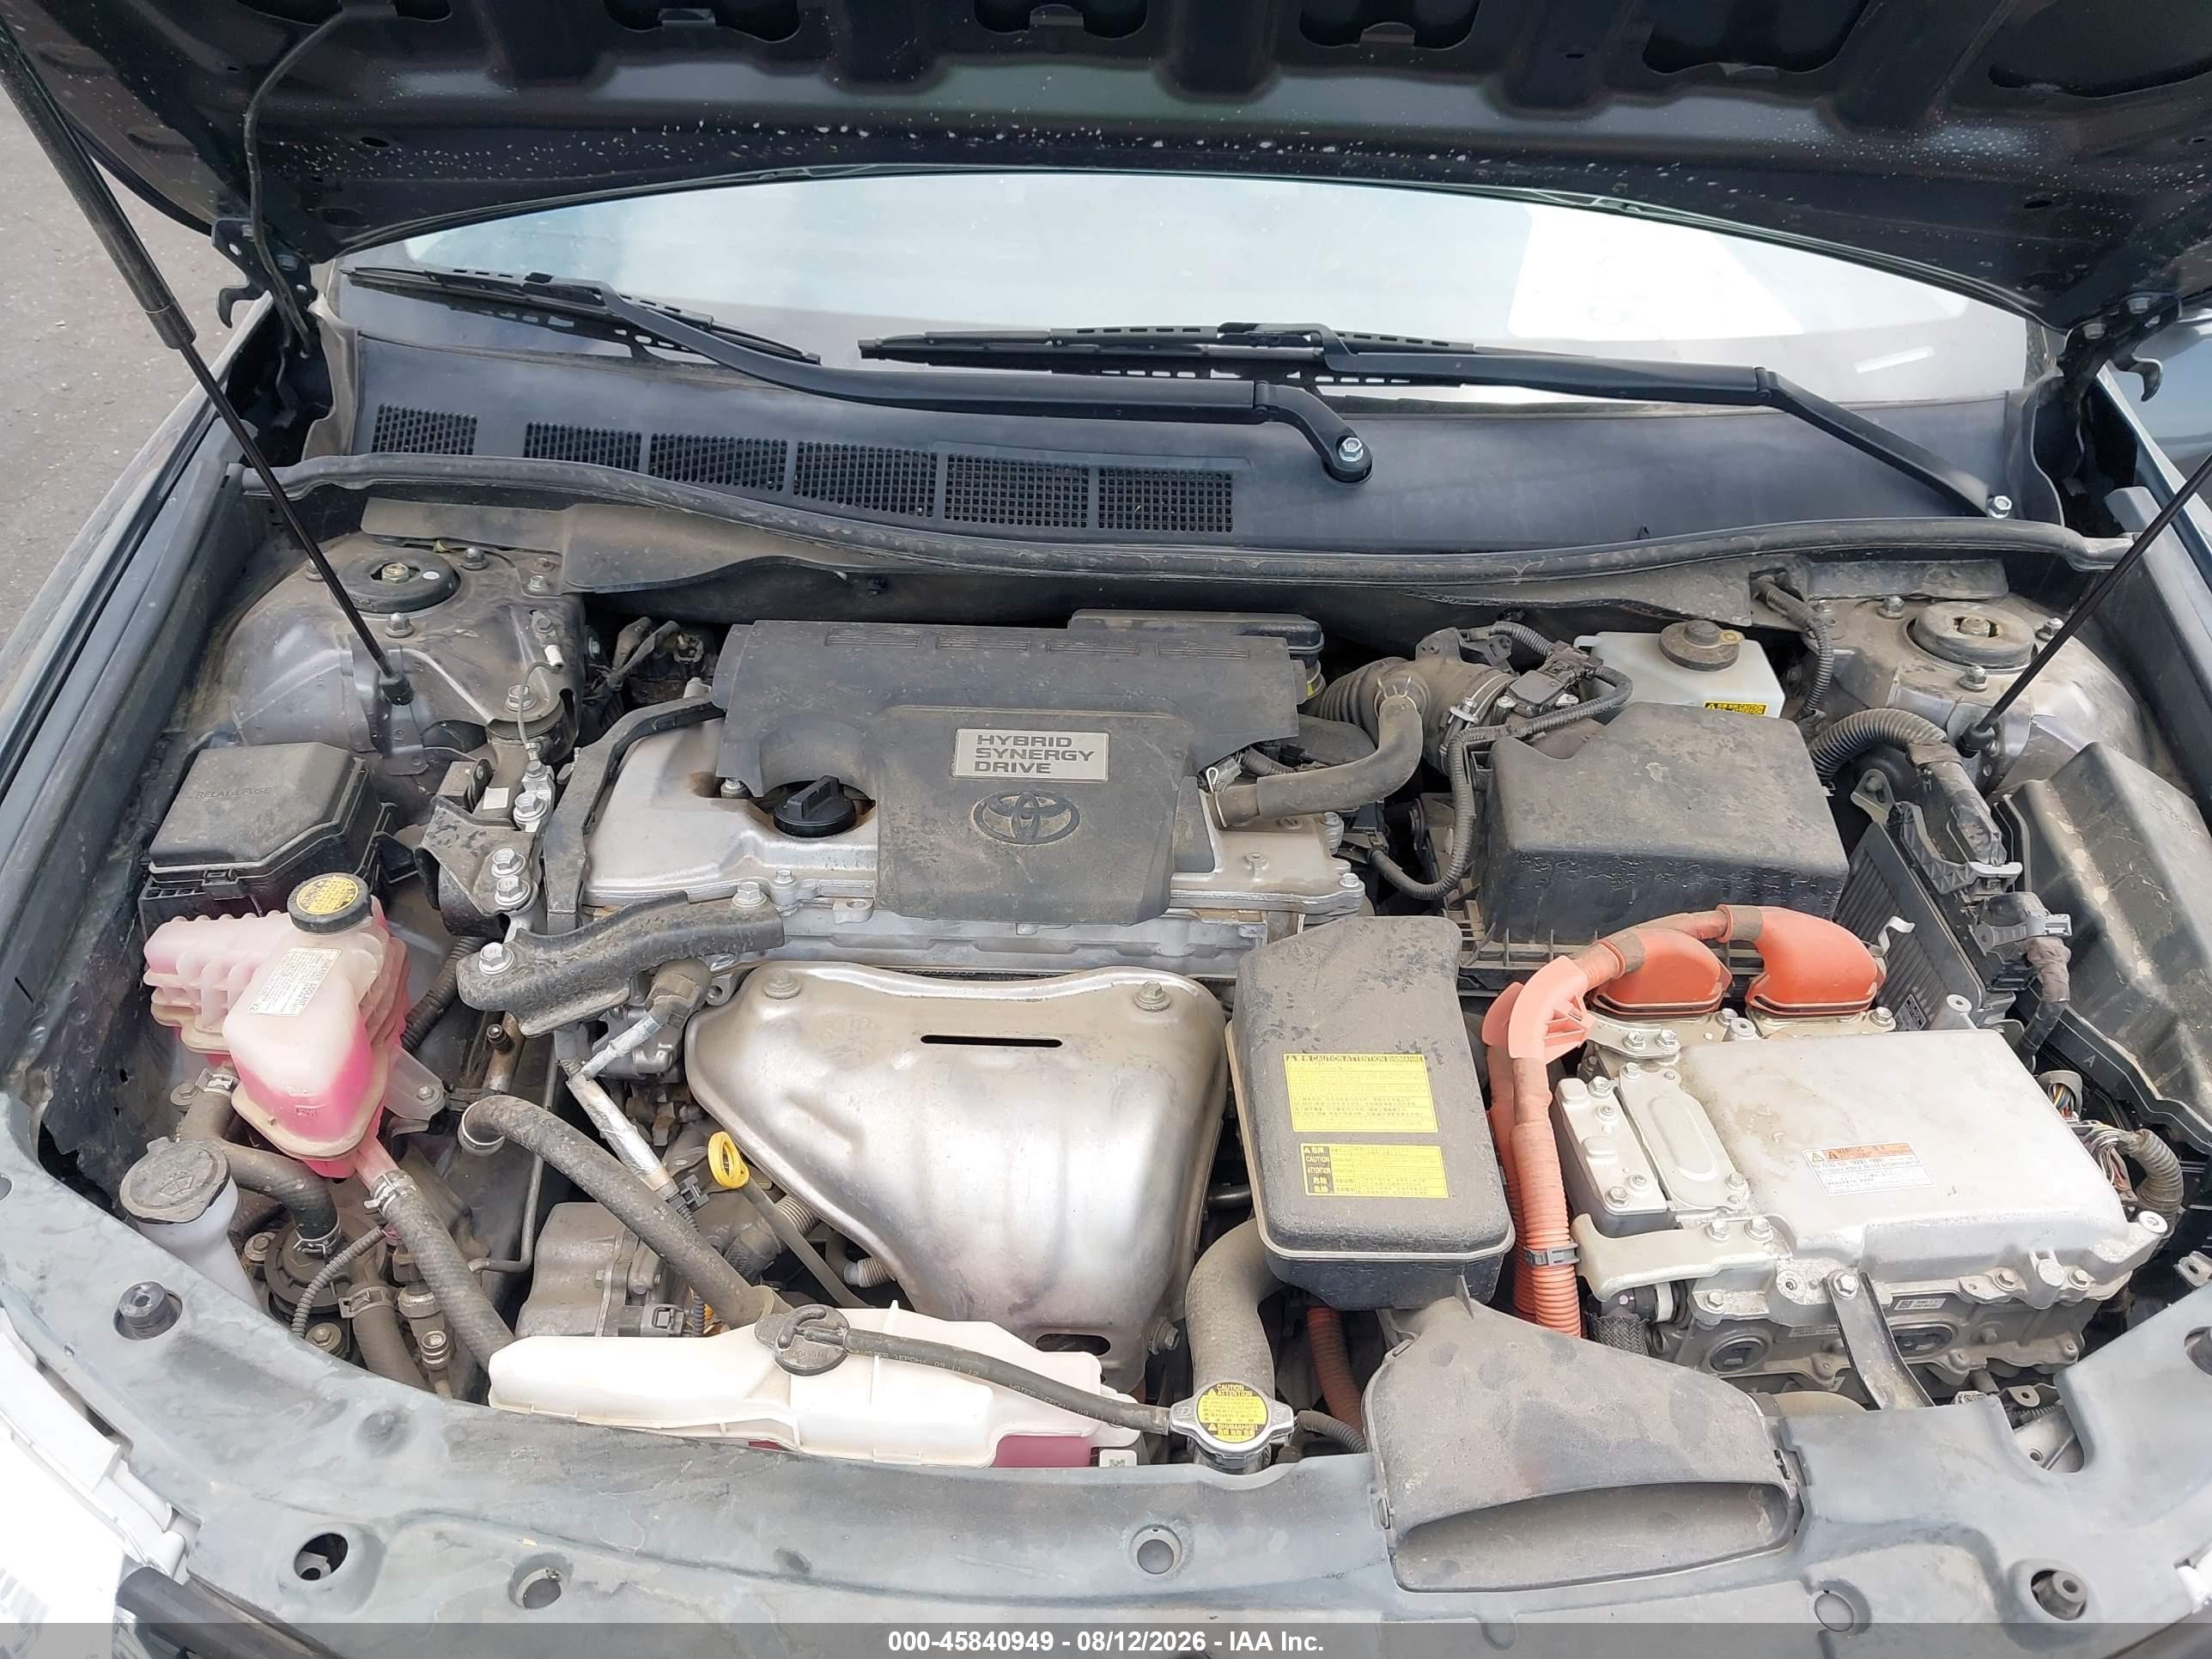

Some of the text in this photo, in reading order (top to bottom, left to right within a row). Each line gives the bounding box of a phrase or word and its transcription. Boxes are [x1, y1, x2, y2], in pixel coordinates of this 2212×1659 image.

[976, 734, 1073, 748] HYBRID
[975, 747, 1095, 762] SYNERGY
[974, 761, 1052, 774] DRIVE
